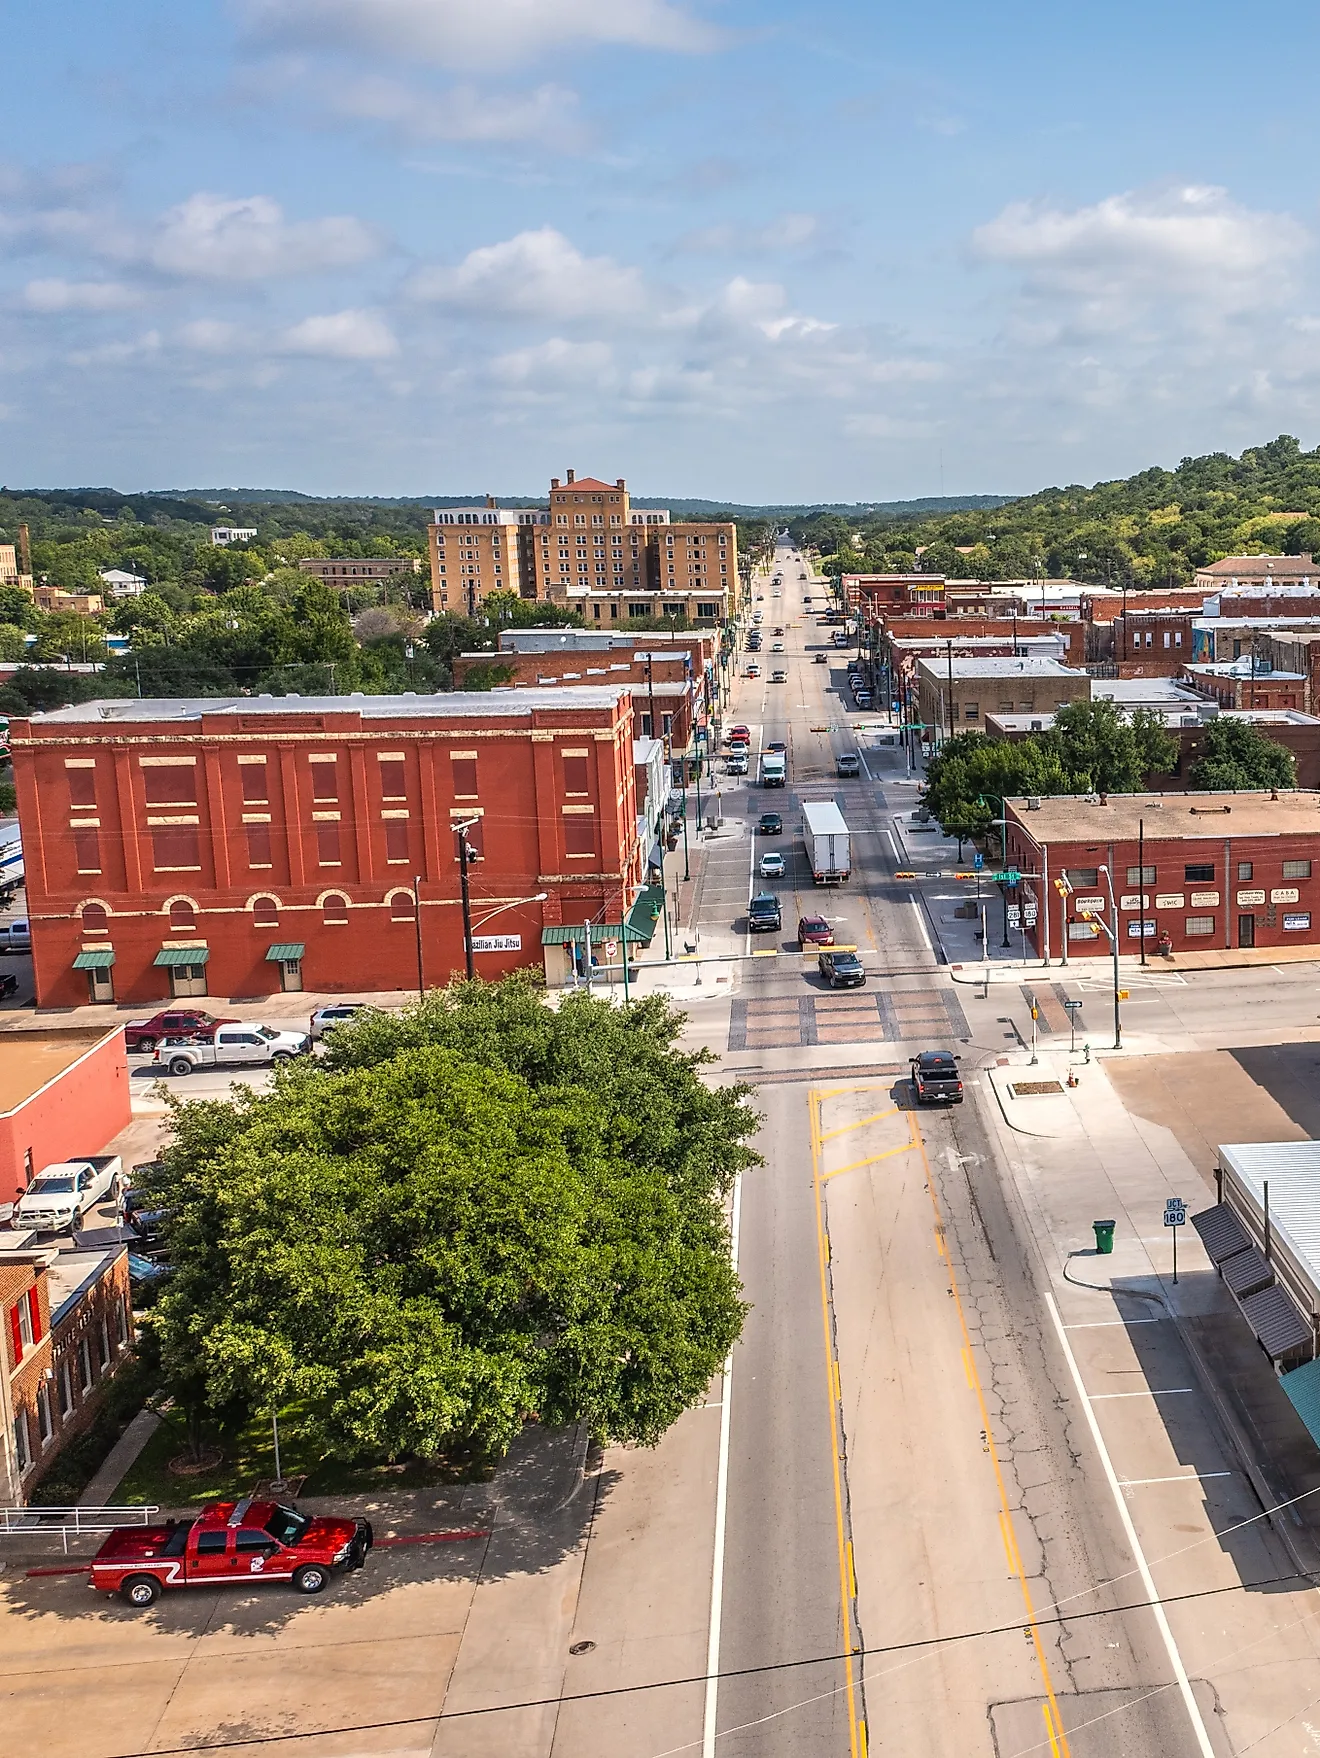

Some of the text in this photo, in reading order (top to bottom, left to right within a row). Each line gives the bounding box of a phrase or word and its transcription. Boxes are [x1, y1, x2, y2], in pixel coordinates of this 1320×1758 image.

[494, 939, 504, 949] Jiu
[504, 938, 520, 948] Jitsu
[1166, 1212, 1184, 1223] 180
